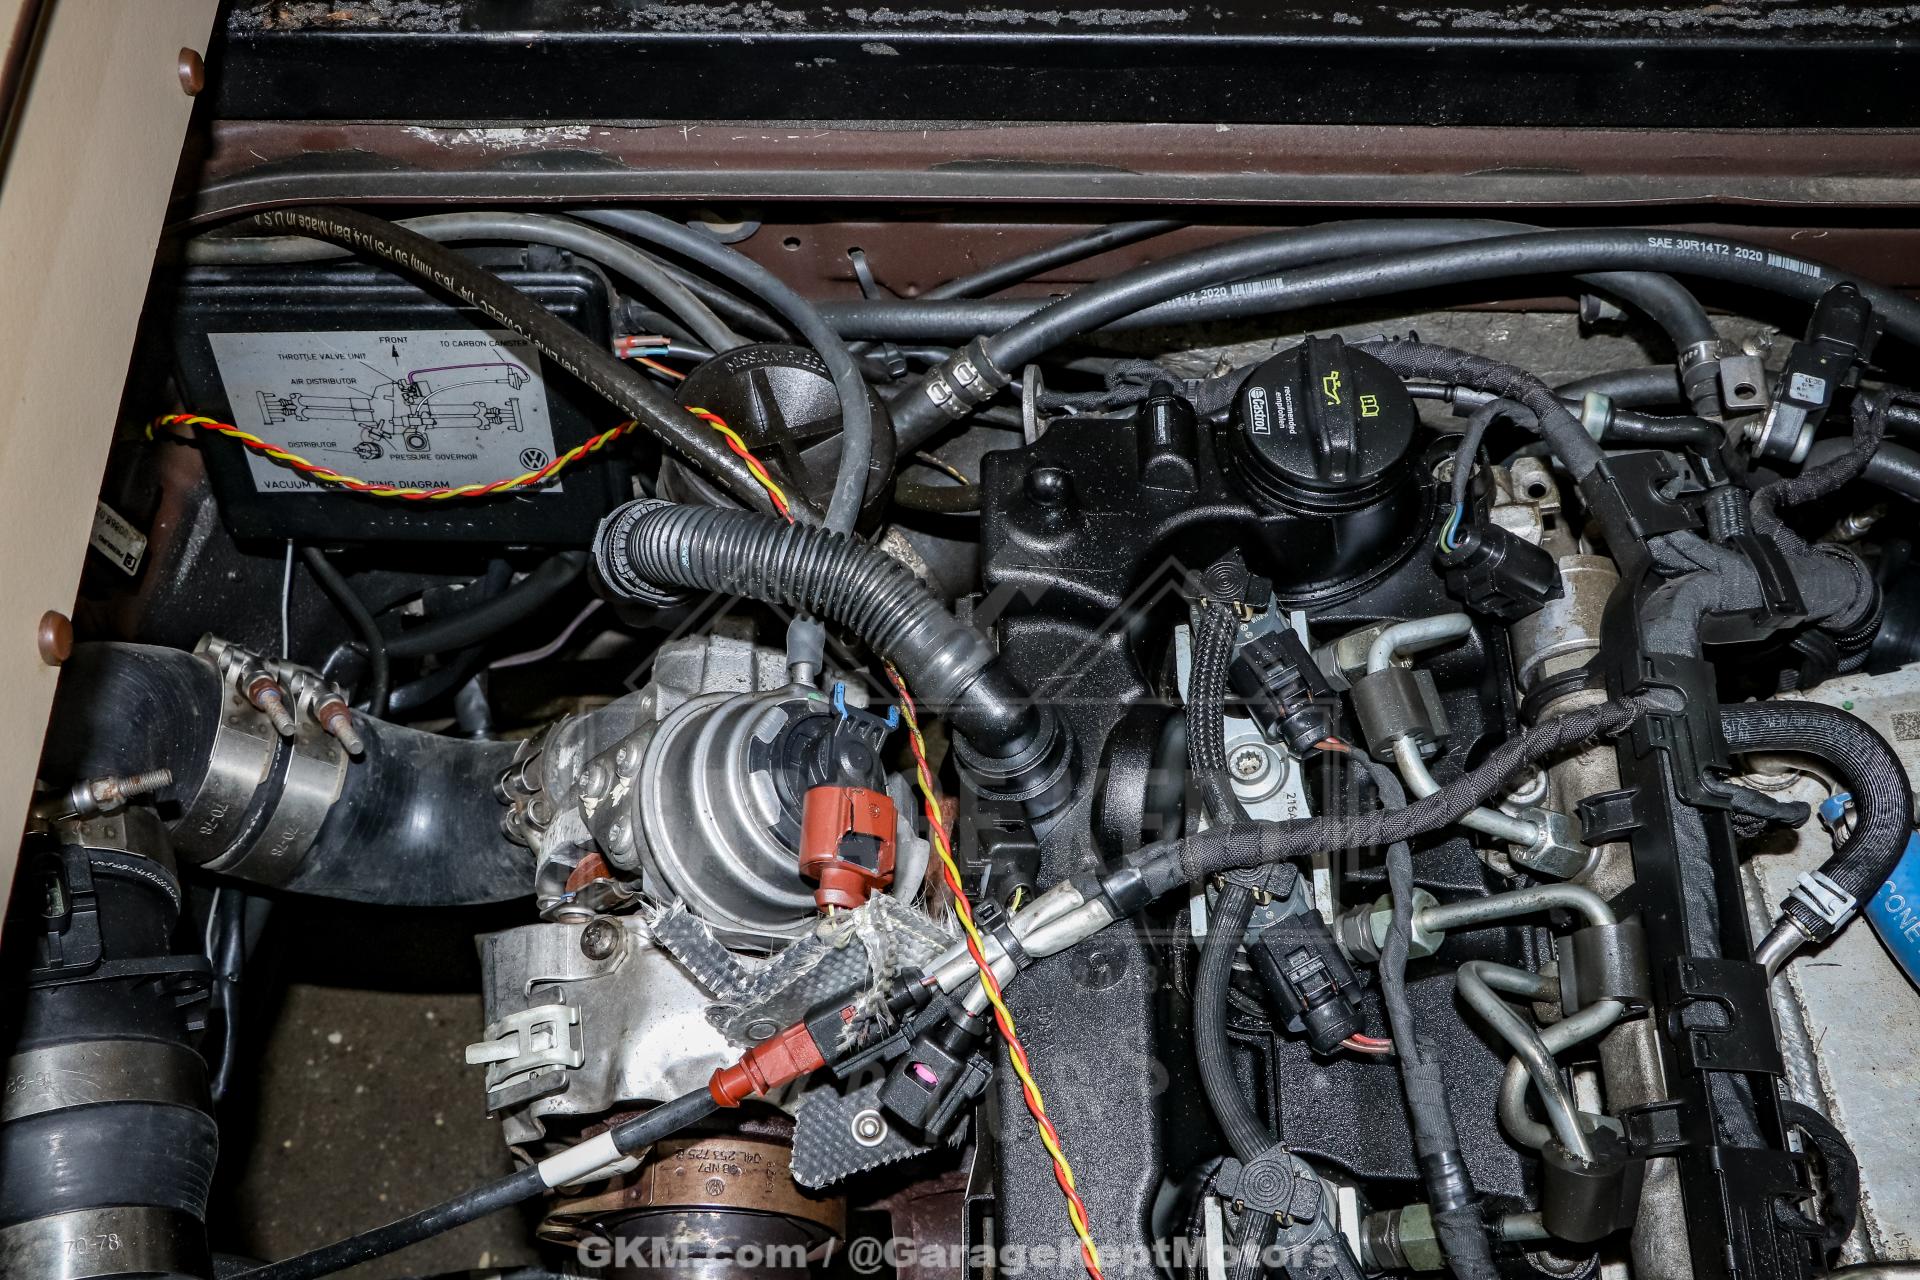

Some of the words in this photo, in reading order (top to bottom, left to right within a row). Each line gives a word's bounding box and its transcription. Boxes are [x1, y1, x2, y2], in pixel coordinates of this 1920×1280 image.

[299, 214, 328, 236] Made
[1648, 237, 1672, 249] SAE
[1677, 239, 1729, 255] 30R14T2
[1735, 247, 1763, 262] 2020
[1201, 287, 1227, 299] 2020
[347, 352, 367, 360] UNIT
[1252, 399, 1267, 431] Castrol
[1275, 391, 1286, 429] empfohlen
[1284, 386, 1297, 434] recommended
[264, 480, 311, 489] VACUUM
[400, 481, 450, 489] DIAGRAM
[200, 804, 229, 835] 70-78
[271, 827, 299, 856] 70-78
[64, 1233, 120, 1256] 70-78
